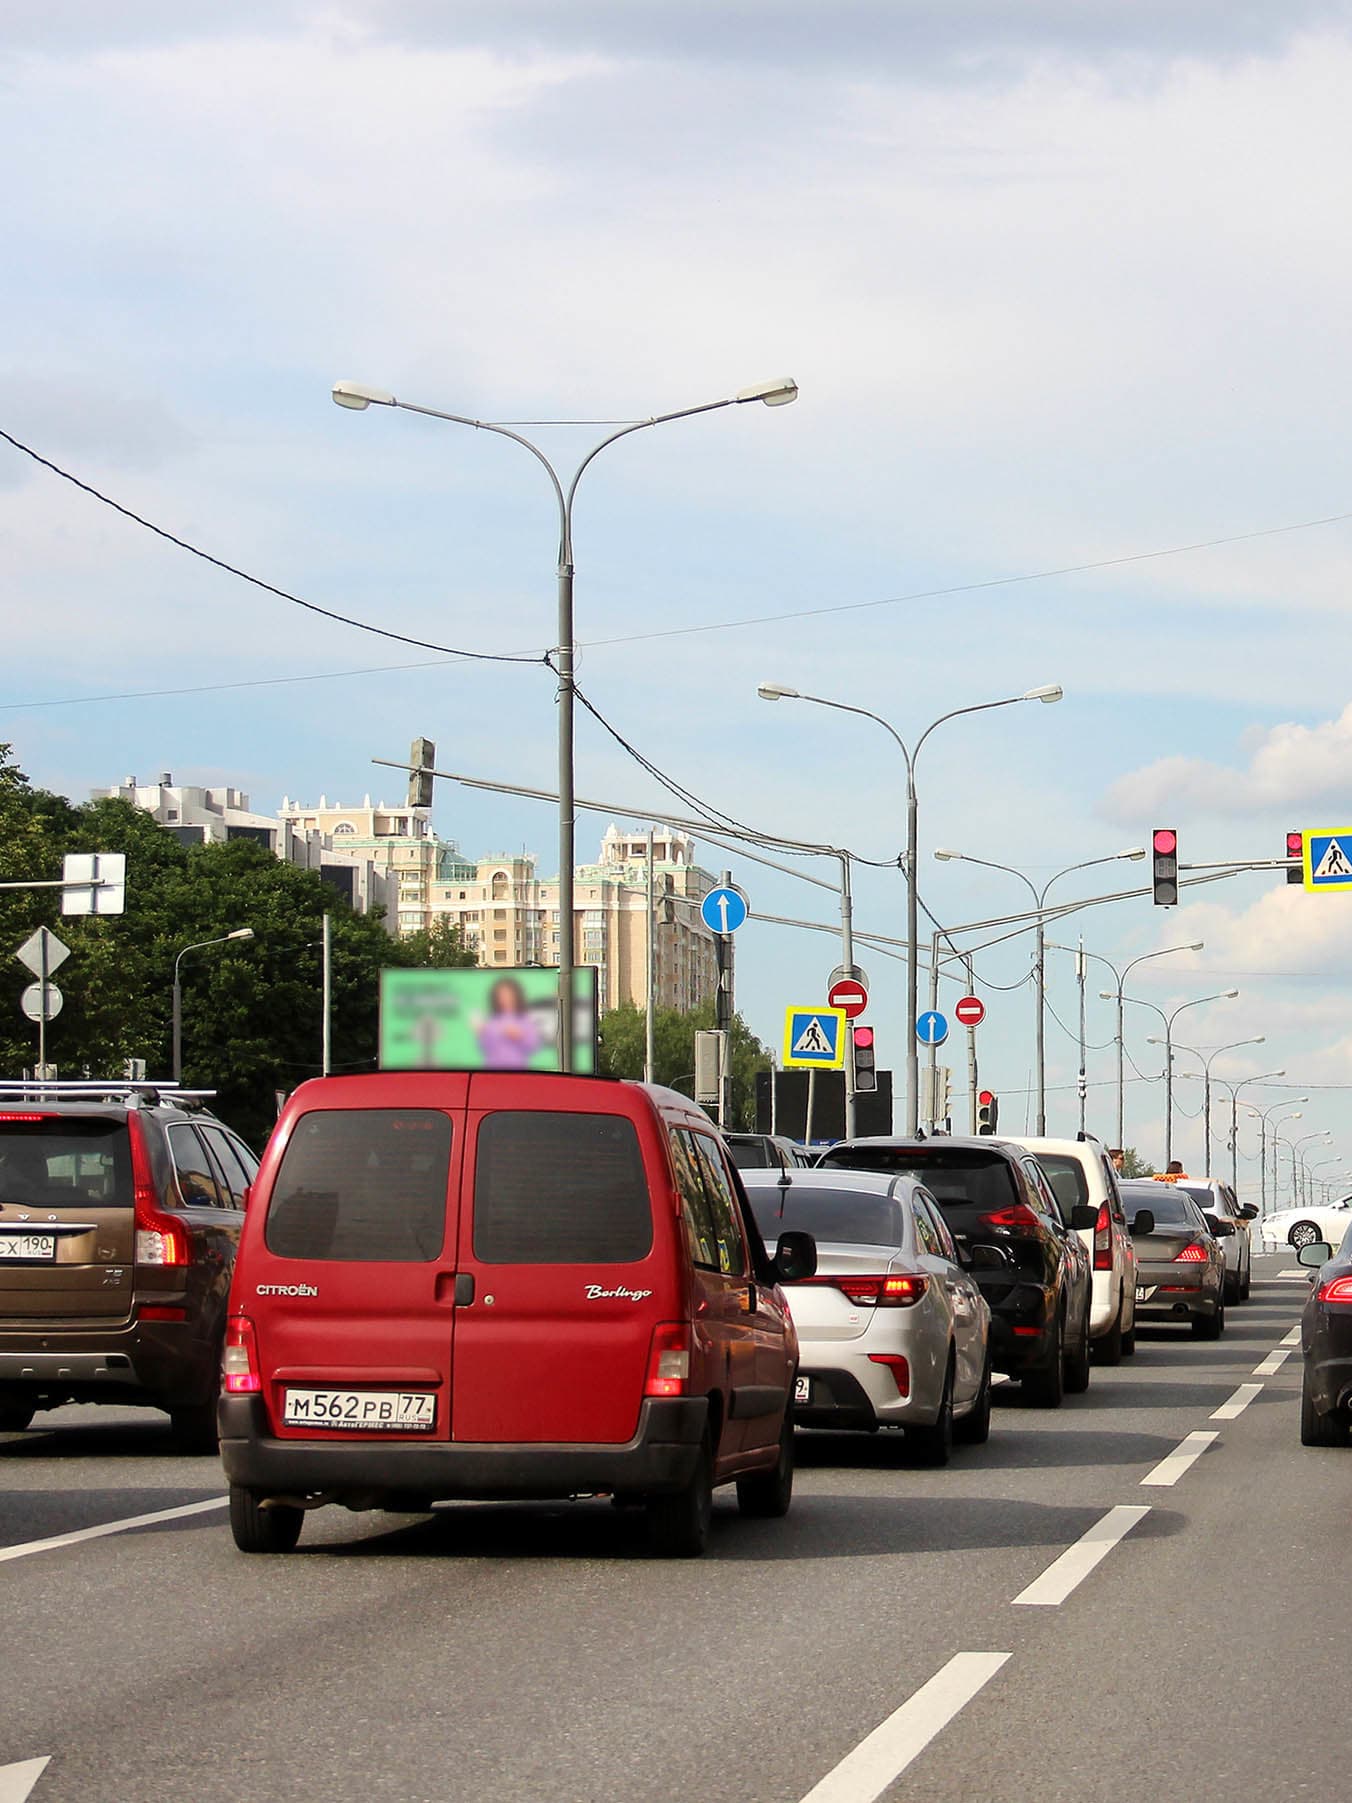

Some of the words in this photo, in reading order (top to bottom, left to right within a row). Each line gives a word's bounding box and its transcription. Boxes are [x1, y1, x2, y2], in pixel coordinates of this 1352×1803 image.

[23, 1237, 49, 1250] 190
[256, 1283, 318, 1297] CITROËN
[583, 1284, 653, 1302] Berlingo
[402, 1395, 427, 1414] 77
[398, 1414, 417, 1422] RUS
